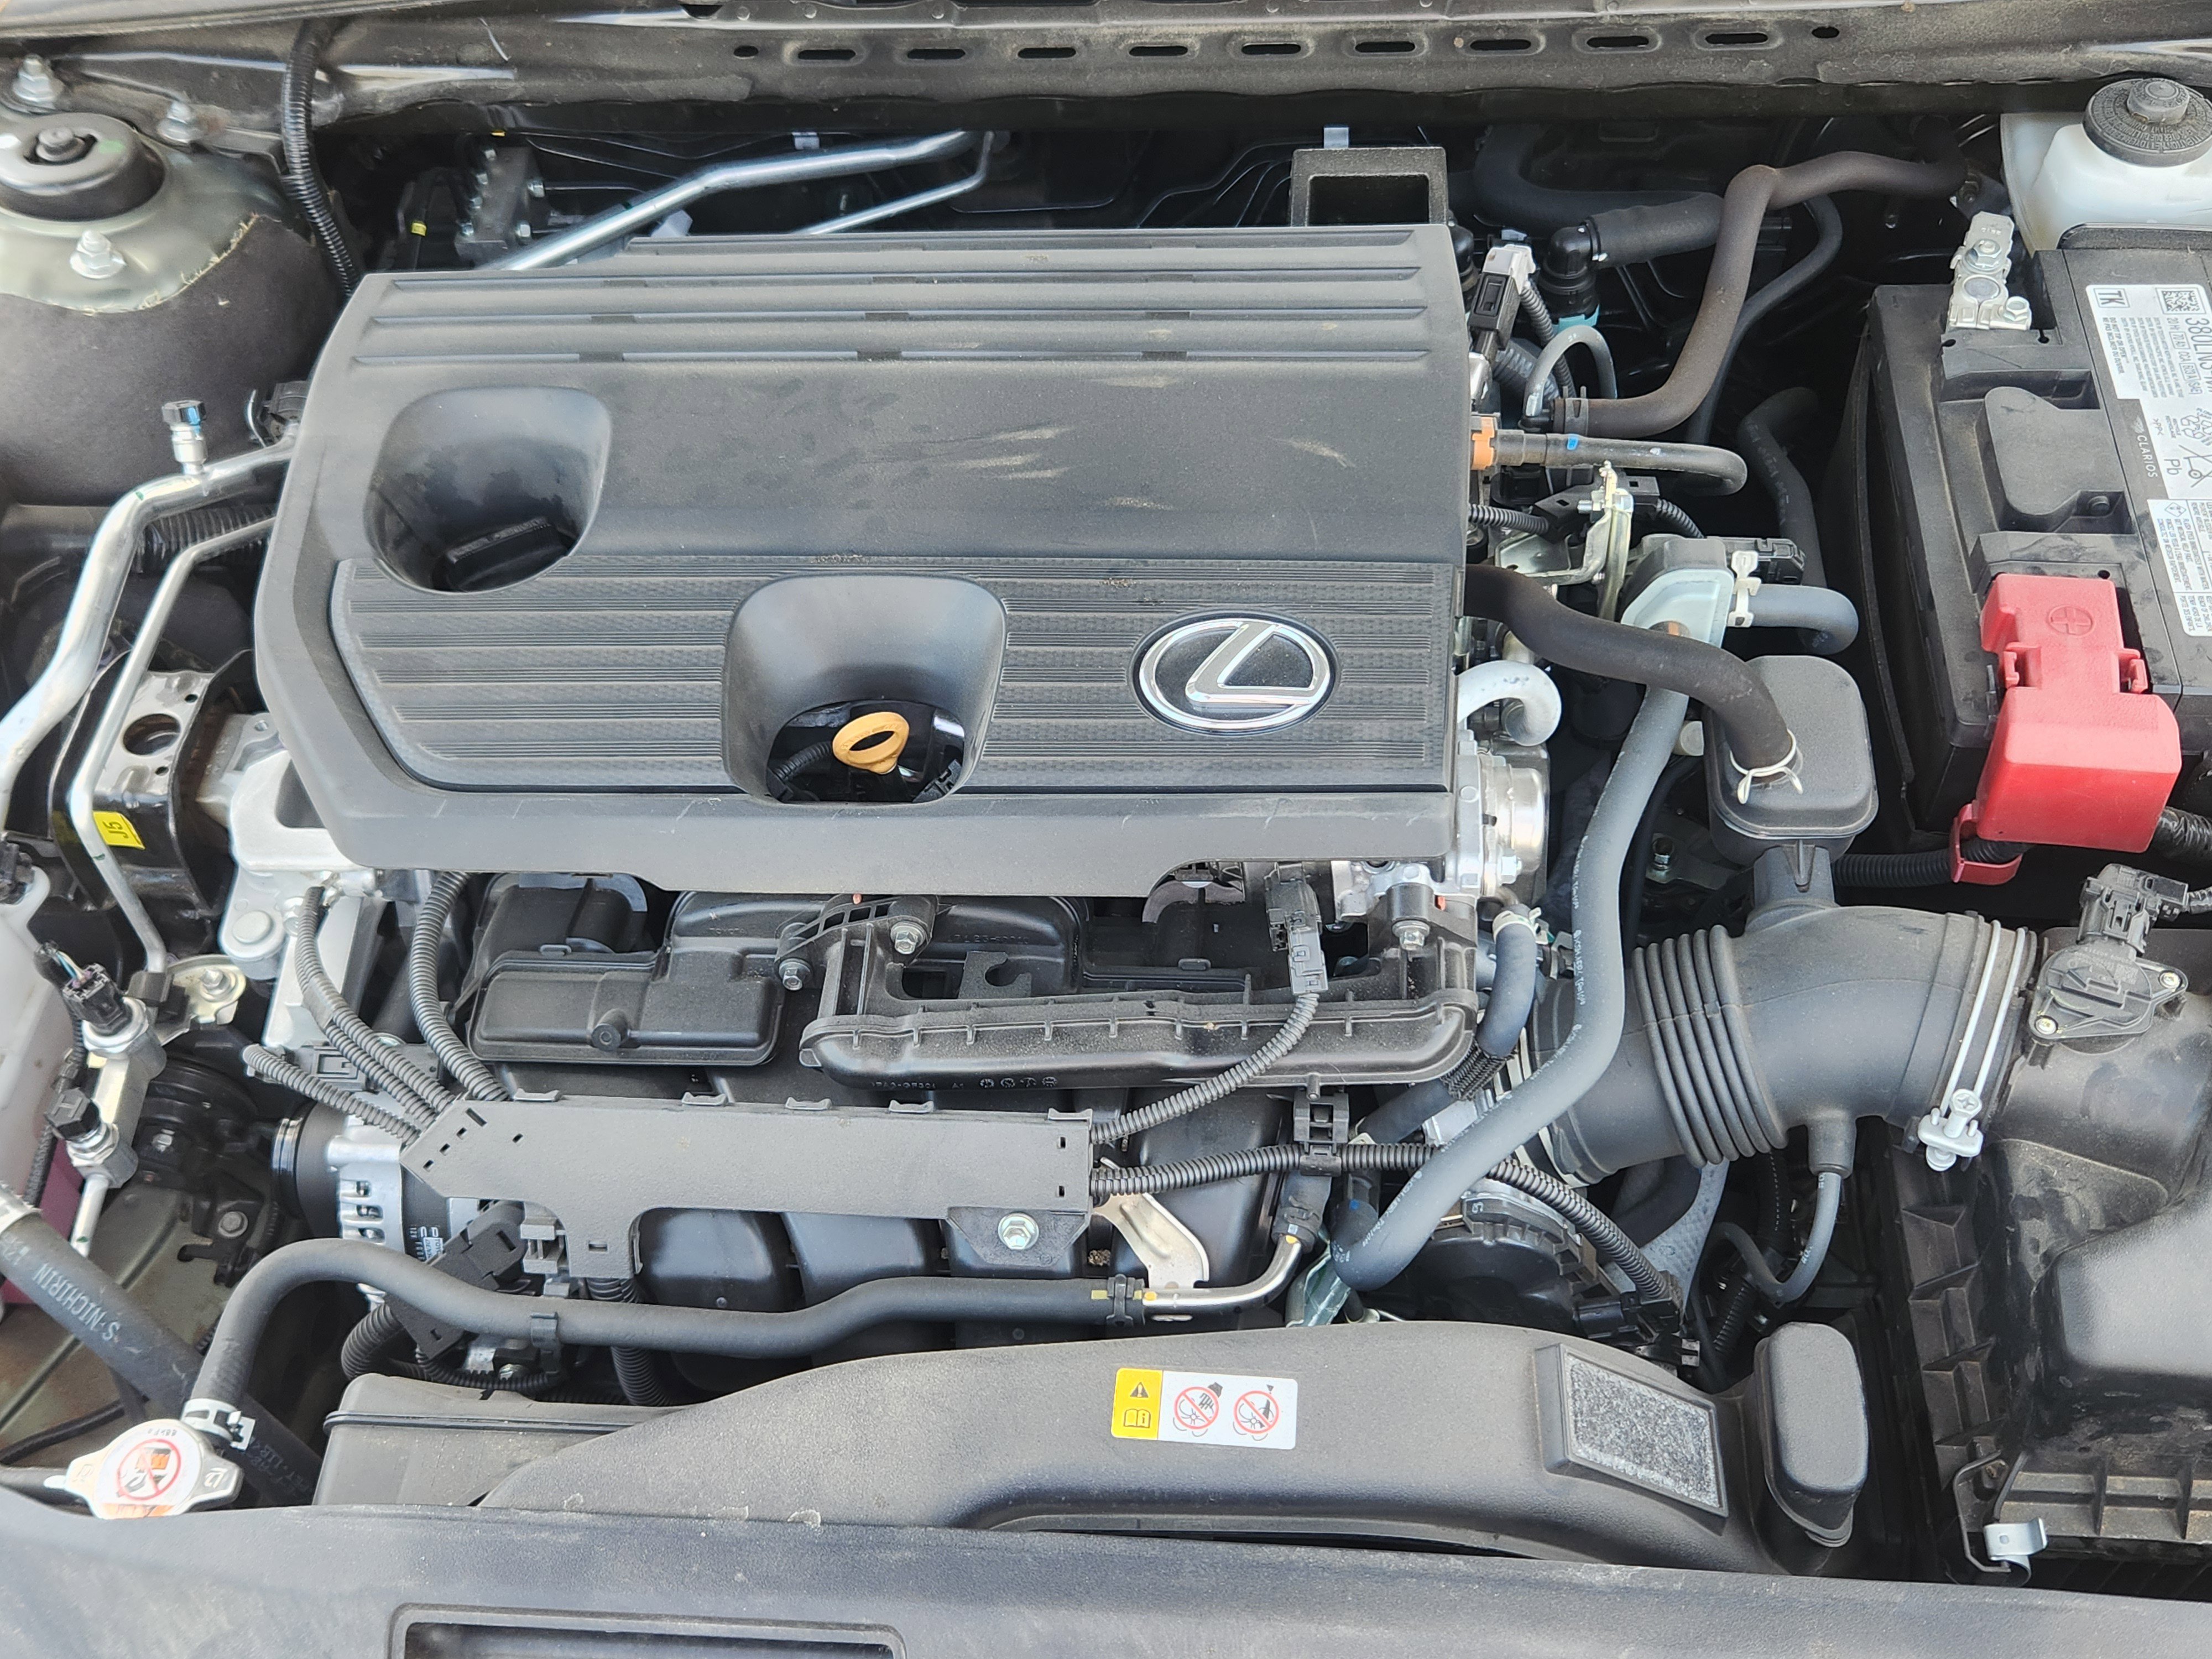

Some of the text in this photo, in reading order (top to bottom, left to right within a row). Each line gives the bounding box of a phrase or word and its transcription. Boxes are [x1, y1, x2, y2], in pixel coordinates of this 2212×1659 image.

[2098, 290, 2126, 305] TK
[2137, 435, 2158, 478] CLARIOS
[2164, 458, 2182, 475] Pb
[102, 820, 129, 839] J5
